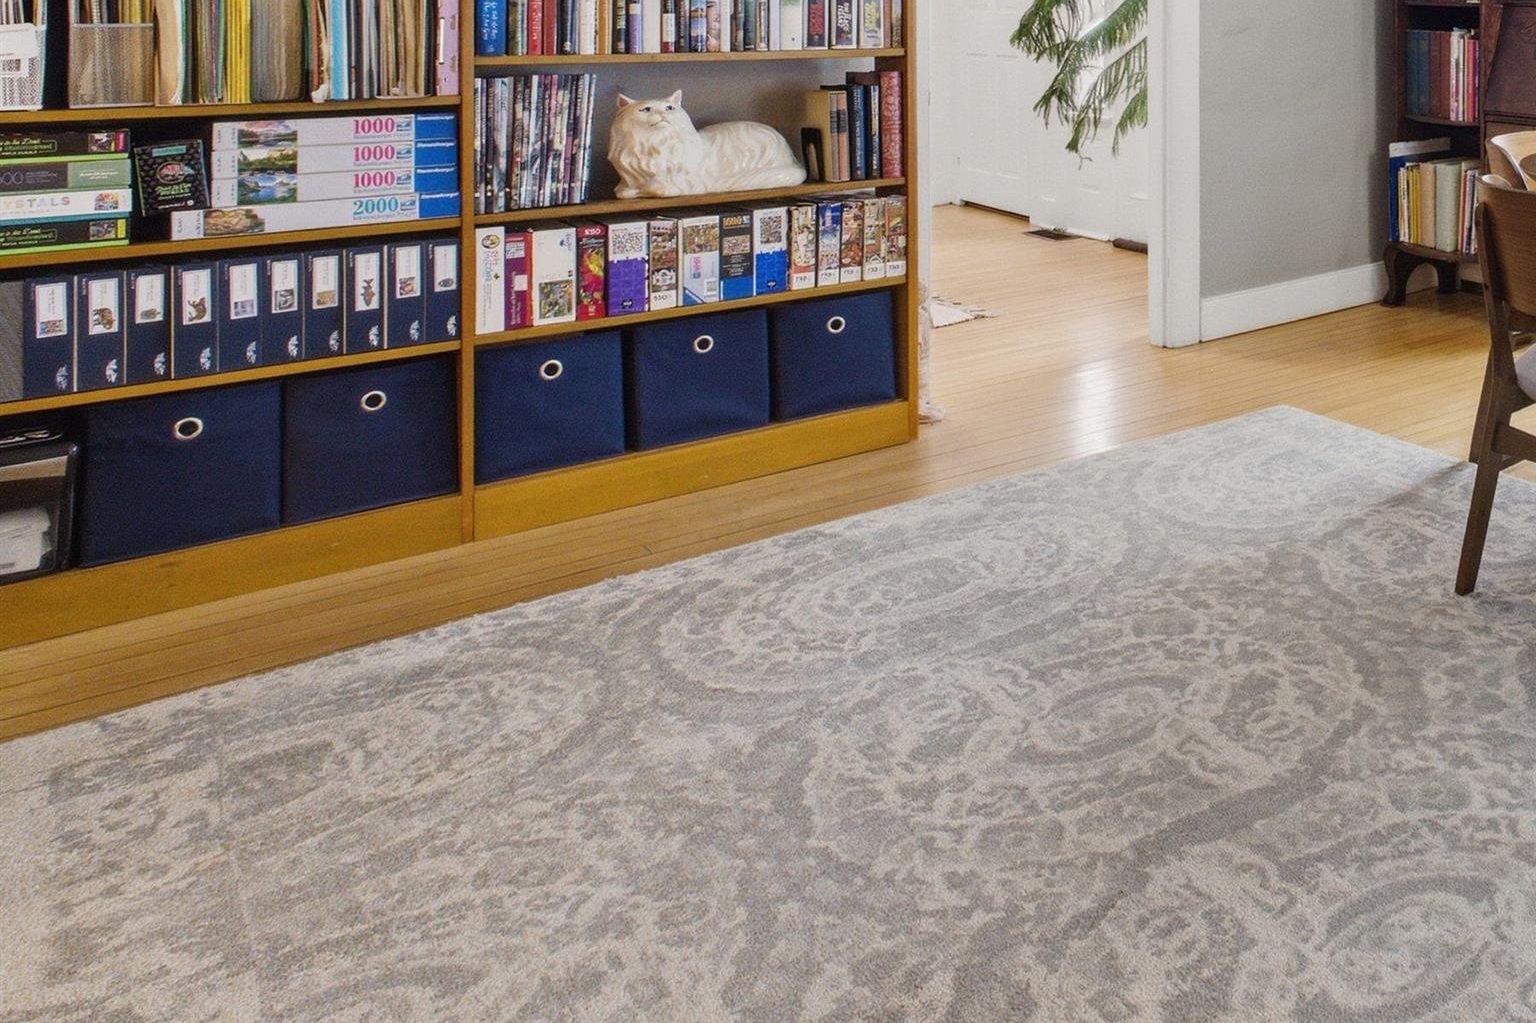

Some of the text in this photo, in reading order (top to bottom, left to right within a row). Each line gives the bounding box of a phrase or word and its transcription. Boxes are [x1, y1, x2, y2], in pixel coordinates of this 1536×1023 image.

[353, 117, 395, 134] 1000
[353, 145, 395, 162] 1000
[353, 171, 395, 188] 1000
[352, 197, 398, 215] 2000
